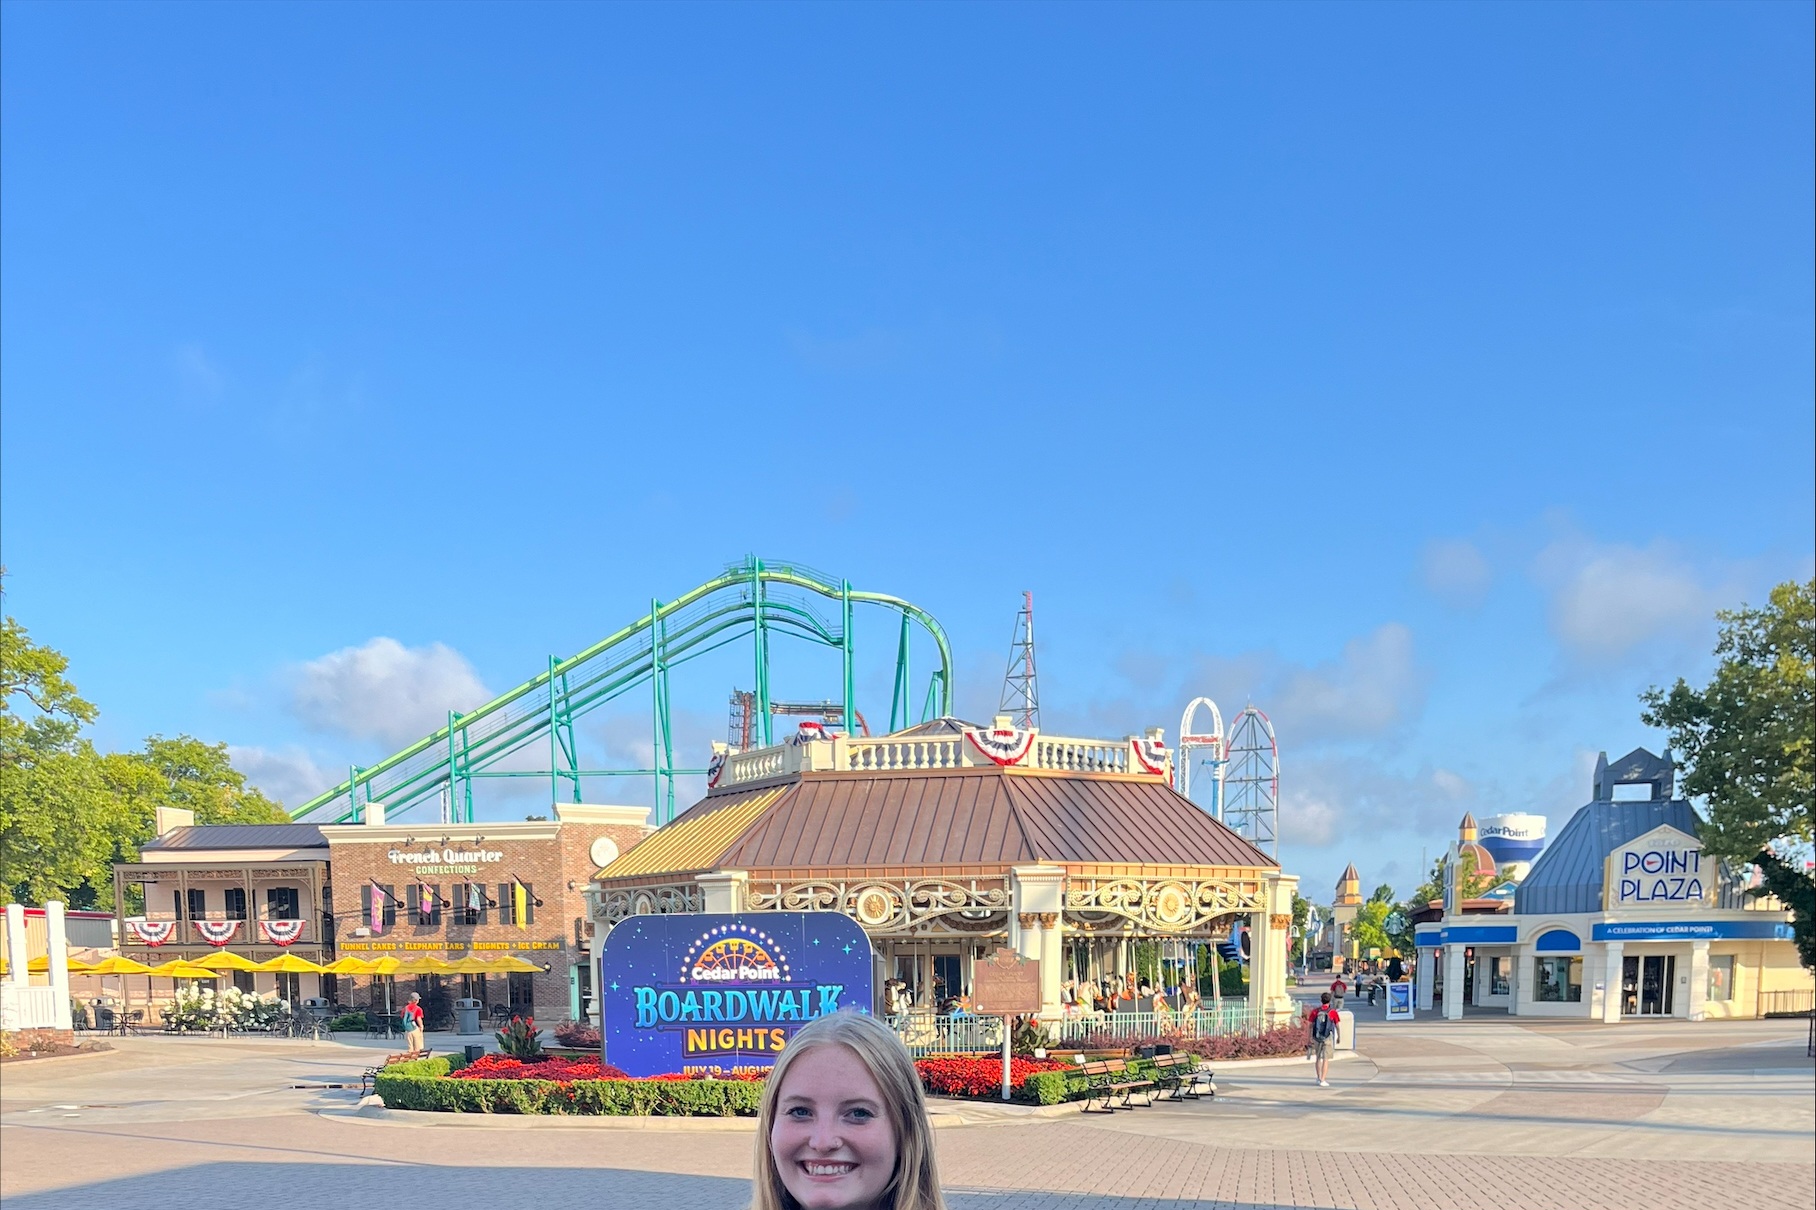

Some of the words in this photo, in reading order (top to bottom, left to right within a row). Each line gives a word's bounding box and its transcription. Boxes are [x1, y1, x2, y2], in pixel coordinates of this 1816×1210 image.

[1502, 827, 1529, 837] Point
[388, 849, 441, 864] French
[443, 848, 503, 864] Quarter
[1624, 850, 1700, 875] POINT
[416, 865, 477, 874] CONFECTIONS
[1620, 878, 1703, 901] PLAZA
[340, 942, 369, 950] FUNNEL
[371, 942, 396, 950] CAKES
[405, 941, 443, 950] ELEPHANT
[444, 942, 464, 950] EARS
[473, 941, 510, 950] BEIGNETS
[518, 941, 530, 949] ICE
[532, 941, 560, 949] CREAM
[691, 965, 738, 981] Cedar
[739, 965, 780, 980] Point
[633, 985, 844, 1028] BOARDWALK
[687, 1028, 786, 1052] NIGHTS
[708, 1065, 722, 1076] 19
